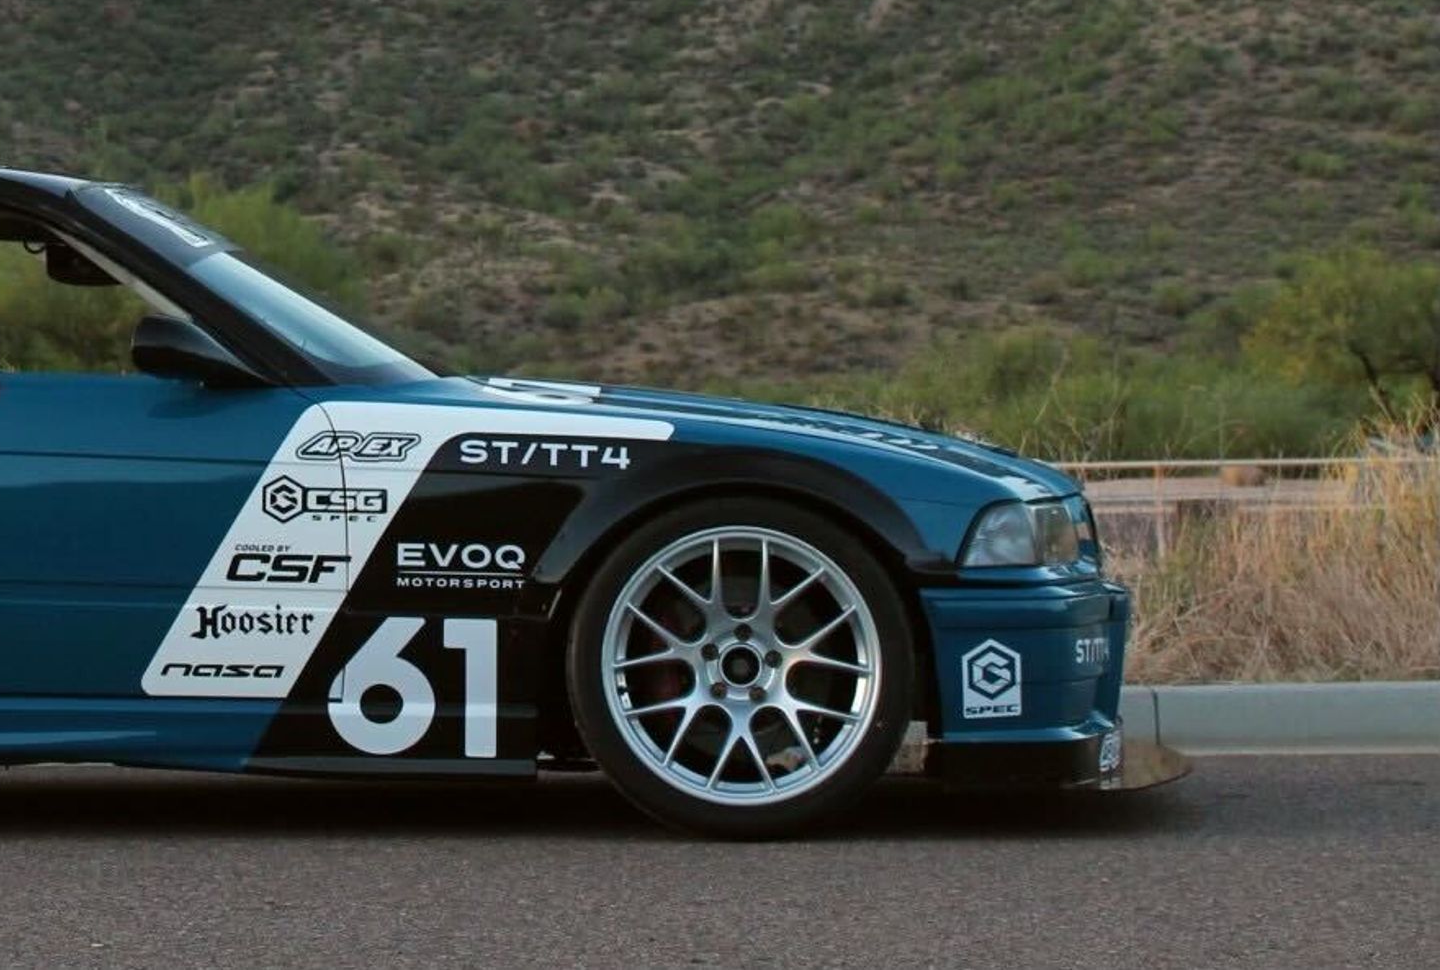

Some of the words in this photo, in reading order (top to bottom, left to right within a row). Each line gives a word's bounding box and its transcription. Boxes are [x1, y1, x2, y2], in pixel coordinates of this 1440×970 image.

[301, 433, 417, 458] APEX
[460, 439, 631, 470] ST/TT4
[306, 489, 385, 512] CSG
[311, 514, 378, 522] SPEC
[234, 543, 275, 551] COOLED
[276, 544, 291, 552] BY
[397, 542, 525, 570] EVOQ
[226, 553, 352, 583] CSF
[396, 577, 525, 589] MOTORSPORT
[190, 603, 314, 640] Hoosier
[327, 616, 497, 758] 61
[965, 704, 1019, 715] SPEC
